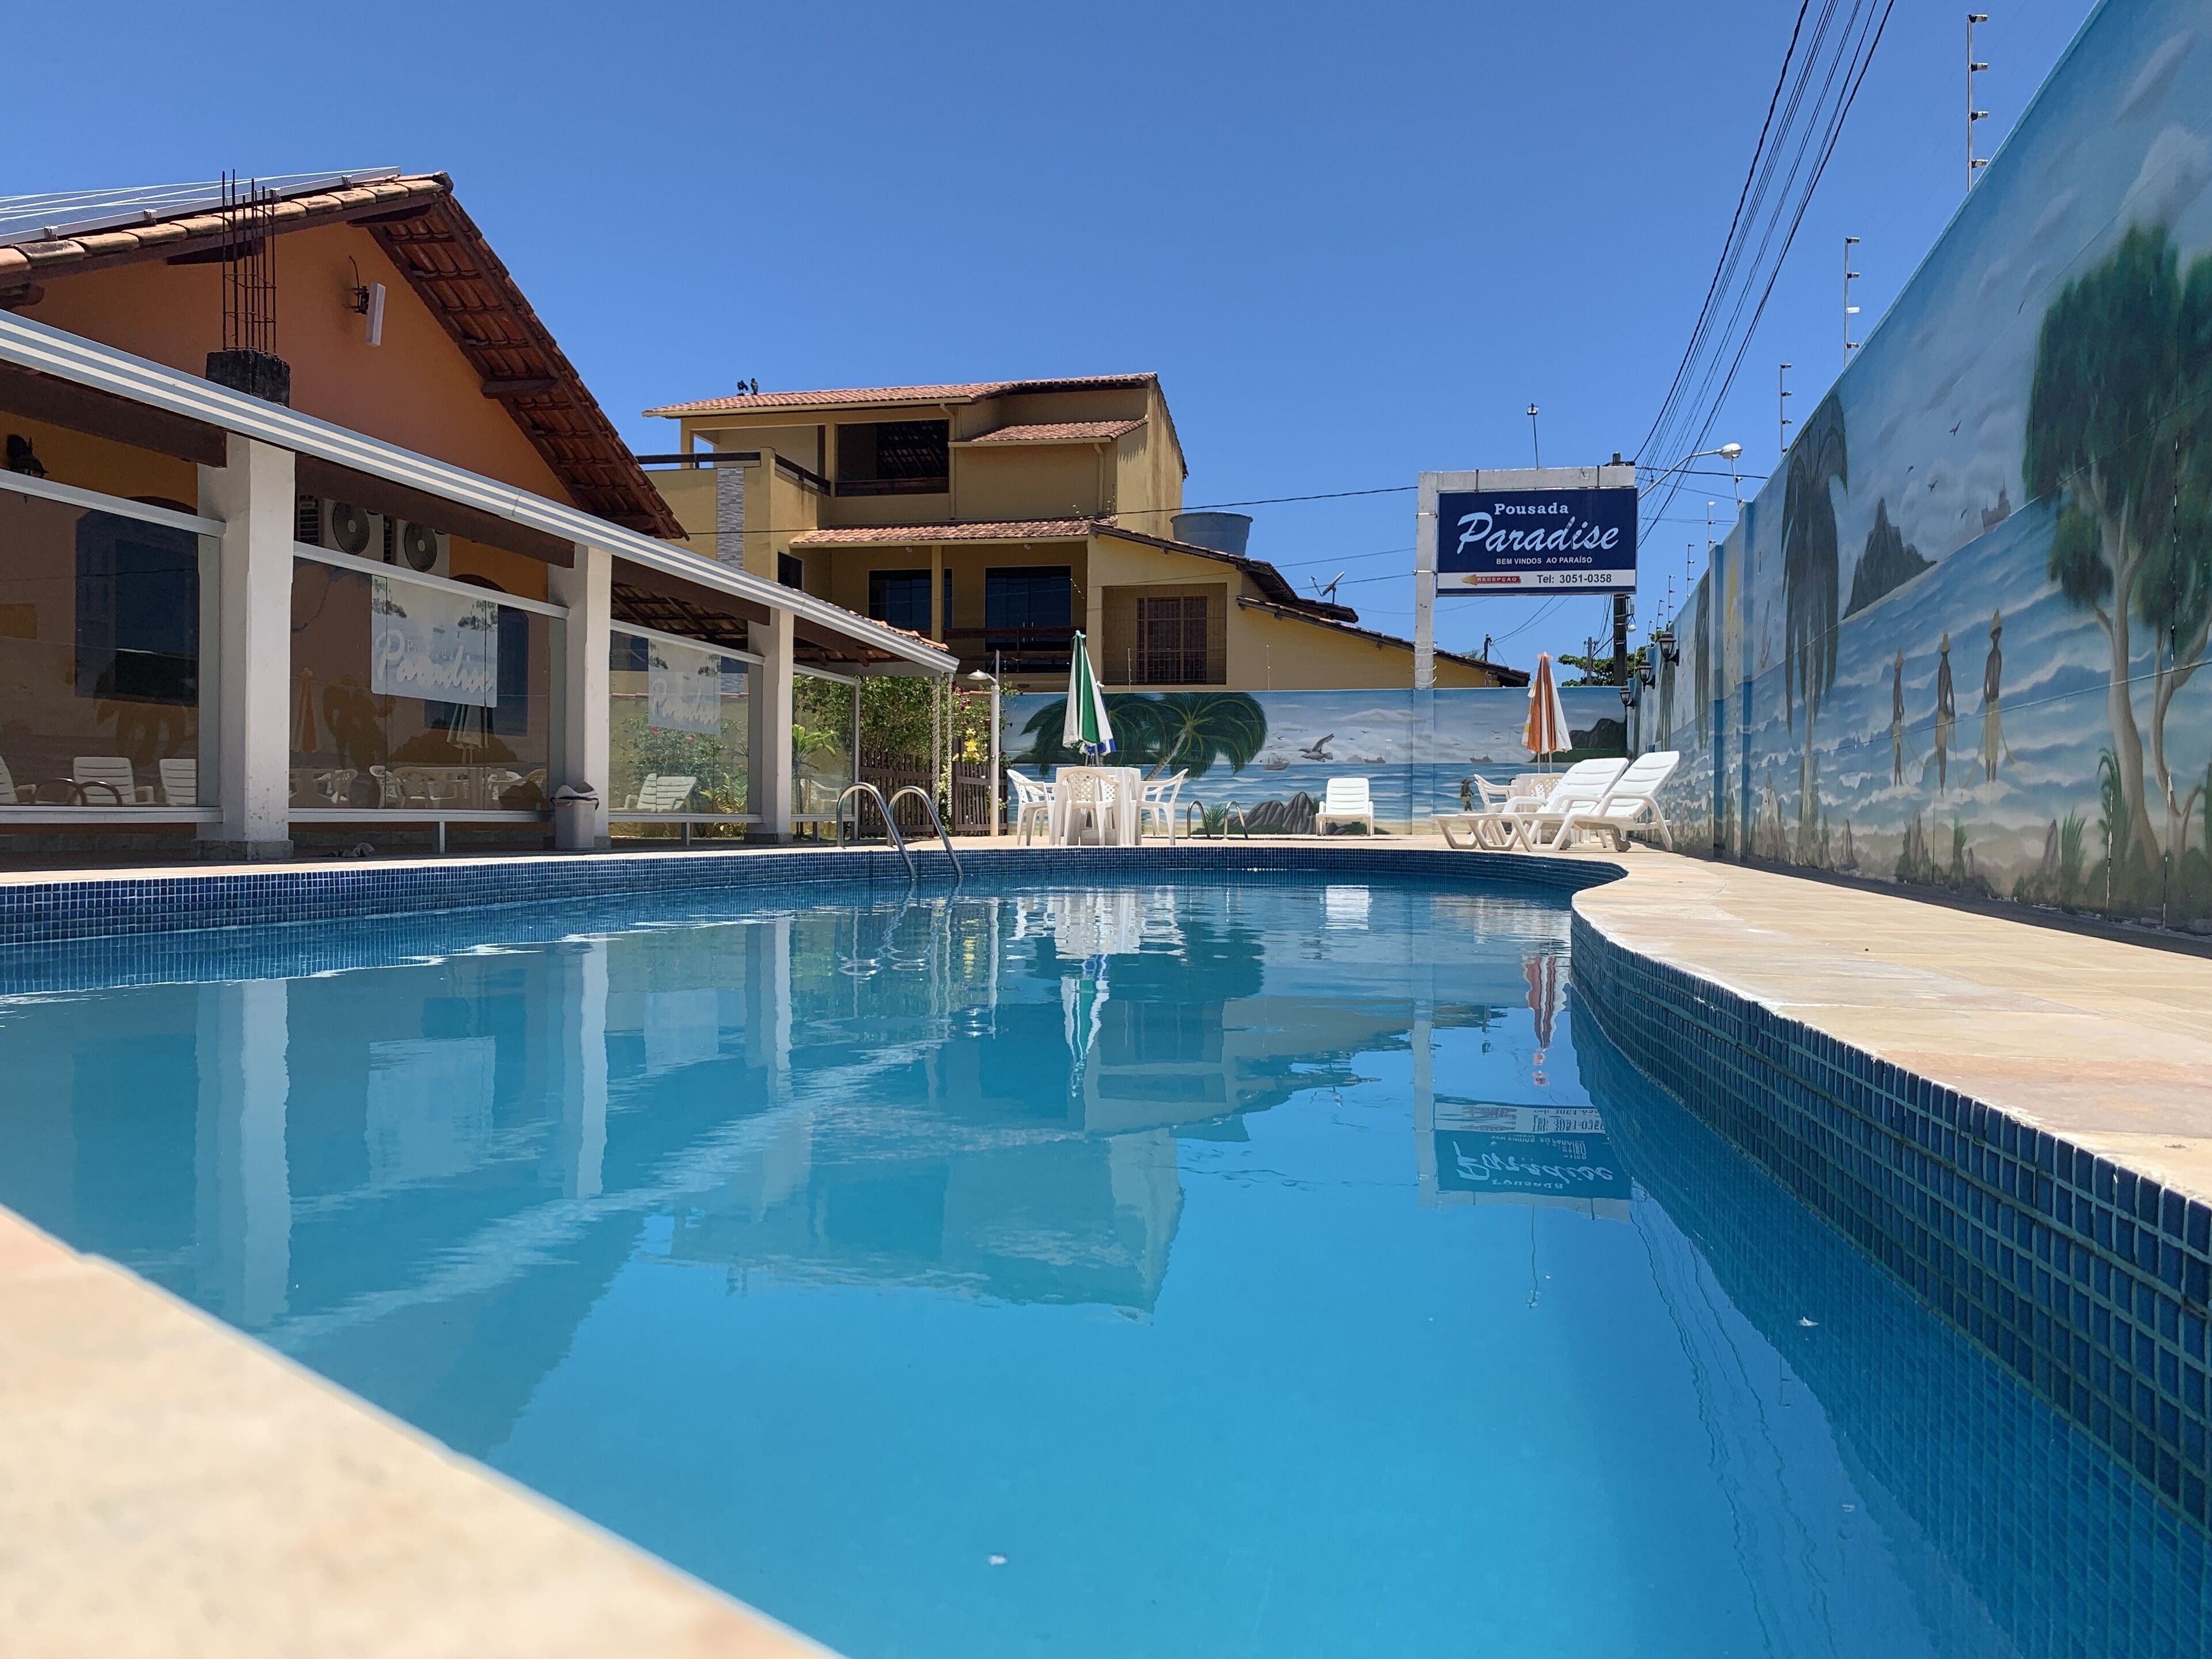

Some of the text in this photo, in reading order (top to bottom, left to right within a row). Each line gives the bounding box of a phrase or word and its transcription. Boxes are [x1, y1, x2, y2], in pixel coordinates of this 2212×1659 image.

[1494, 502, 1569, 515] Pousada
[1457, 512, 1619, 554] Paradise
[1496, 557, 1512, 565] BEM
[1514, 557, 1542, 565] VINDOS
[1559, 555, 1593, 564] PARAÍSO
[1537, 573, 1612, 584] Tel: 3051-0358
